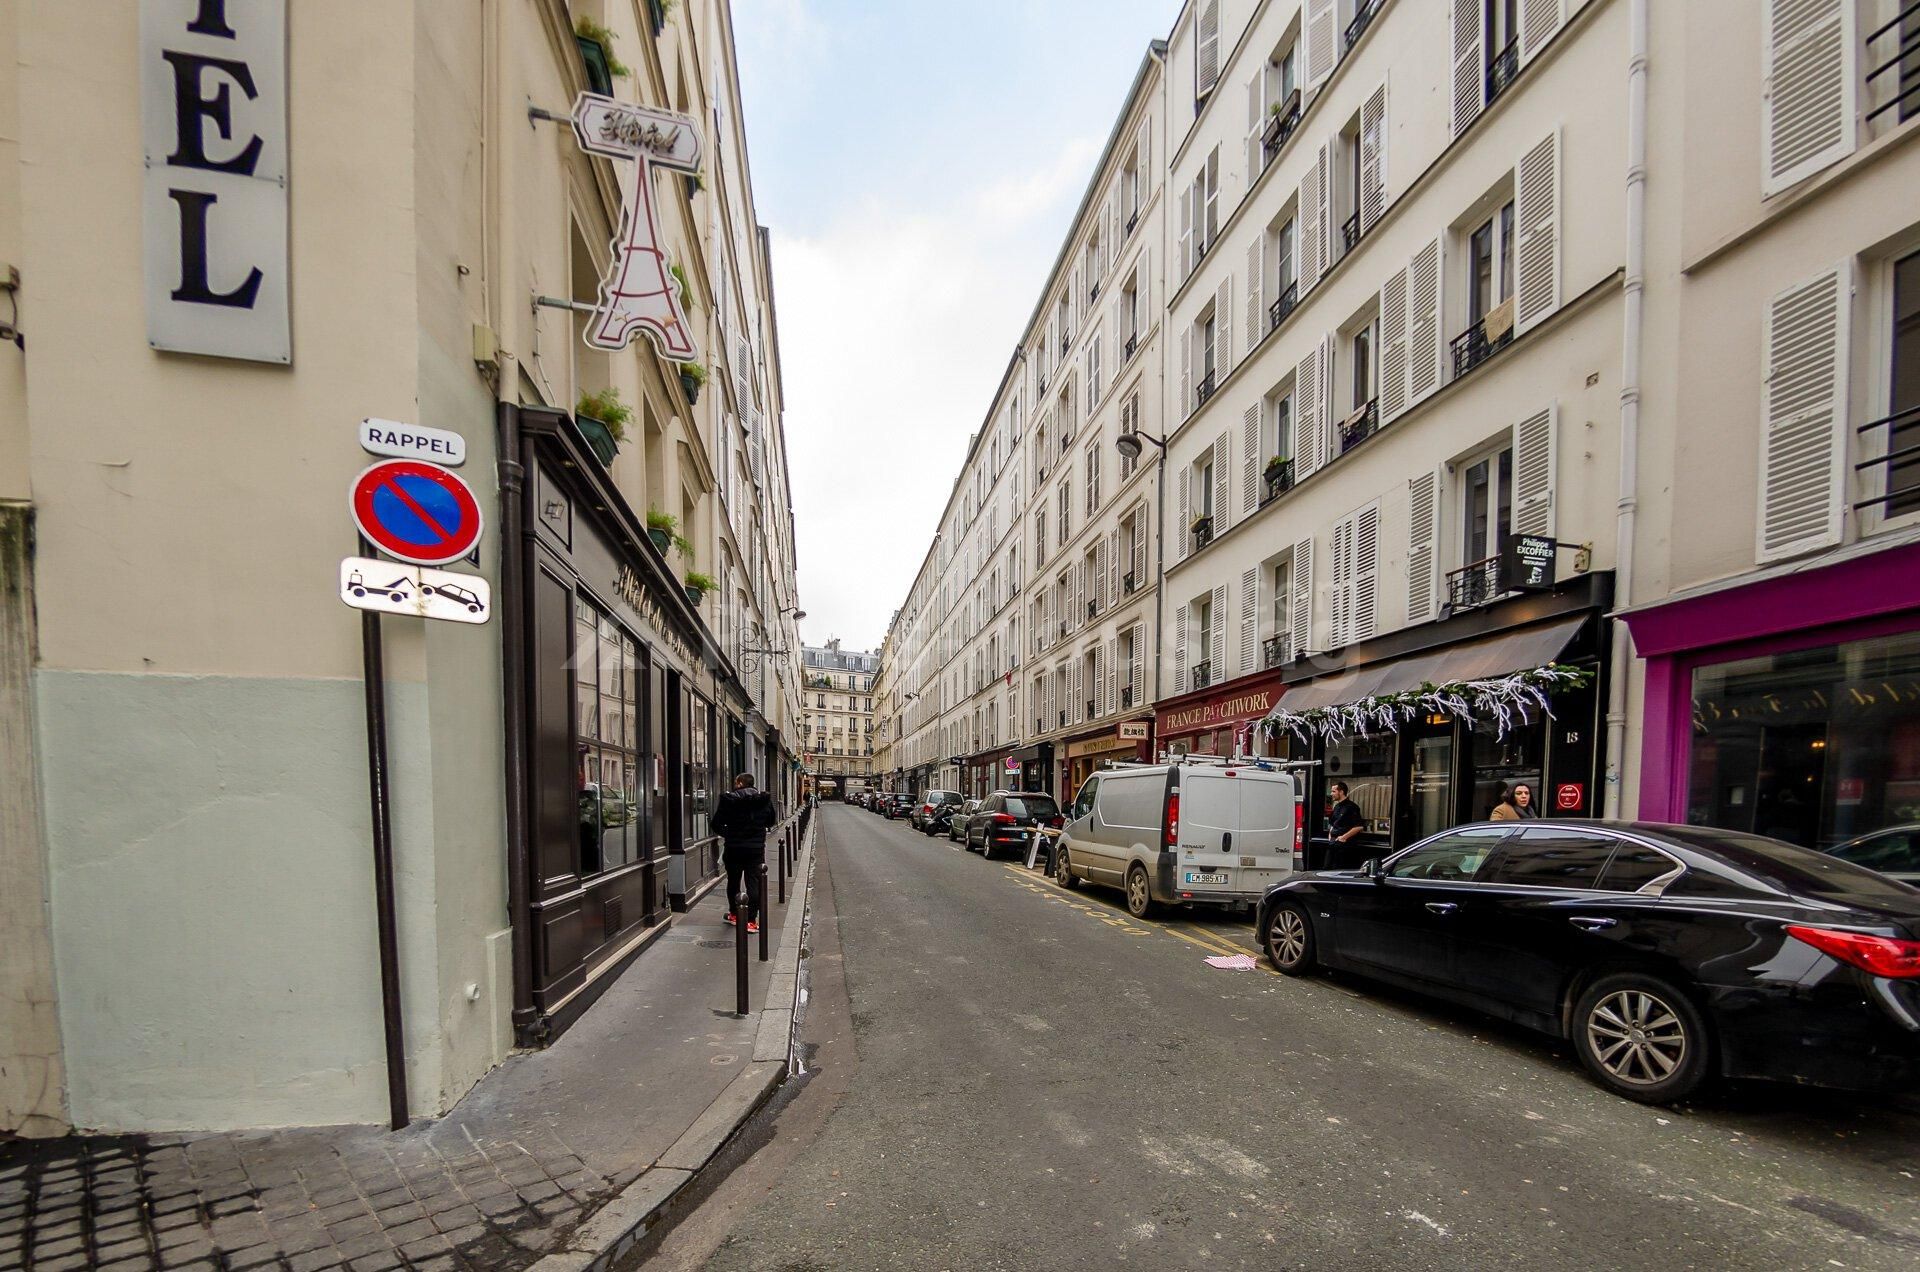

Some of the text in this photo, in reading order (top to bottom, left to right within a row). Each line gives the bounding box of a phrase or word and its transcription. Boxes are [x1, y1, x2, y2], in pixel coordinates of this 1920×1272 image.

[369, 428, 457, 456] RAPPEL
[1516, 545, 1554, 558] EXCOFFIER
[1166, 691, 1270, 730] FRANCE PATCHWORK
[1566, 731, 1578, 744] 18
